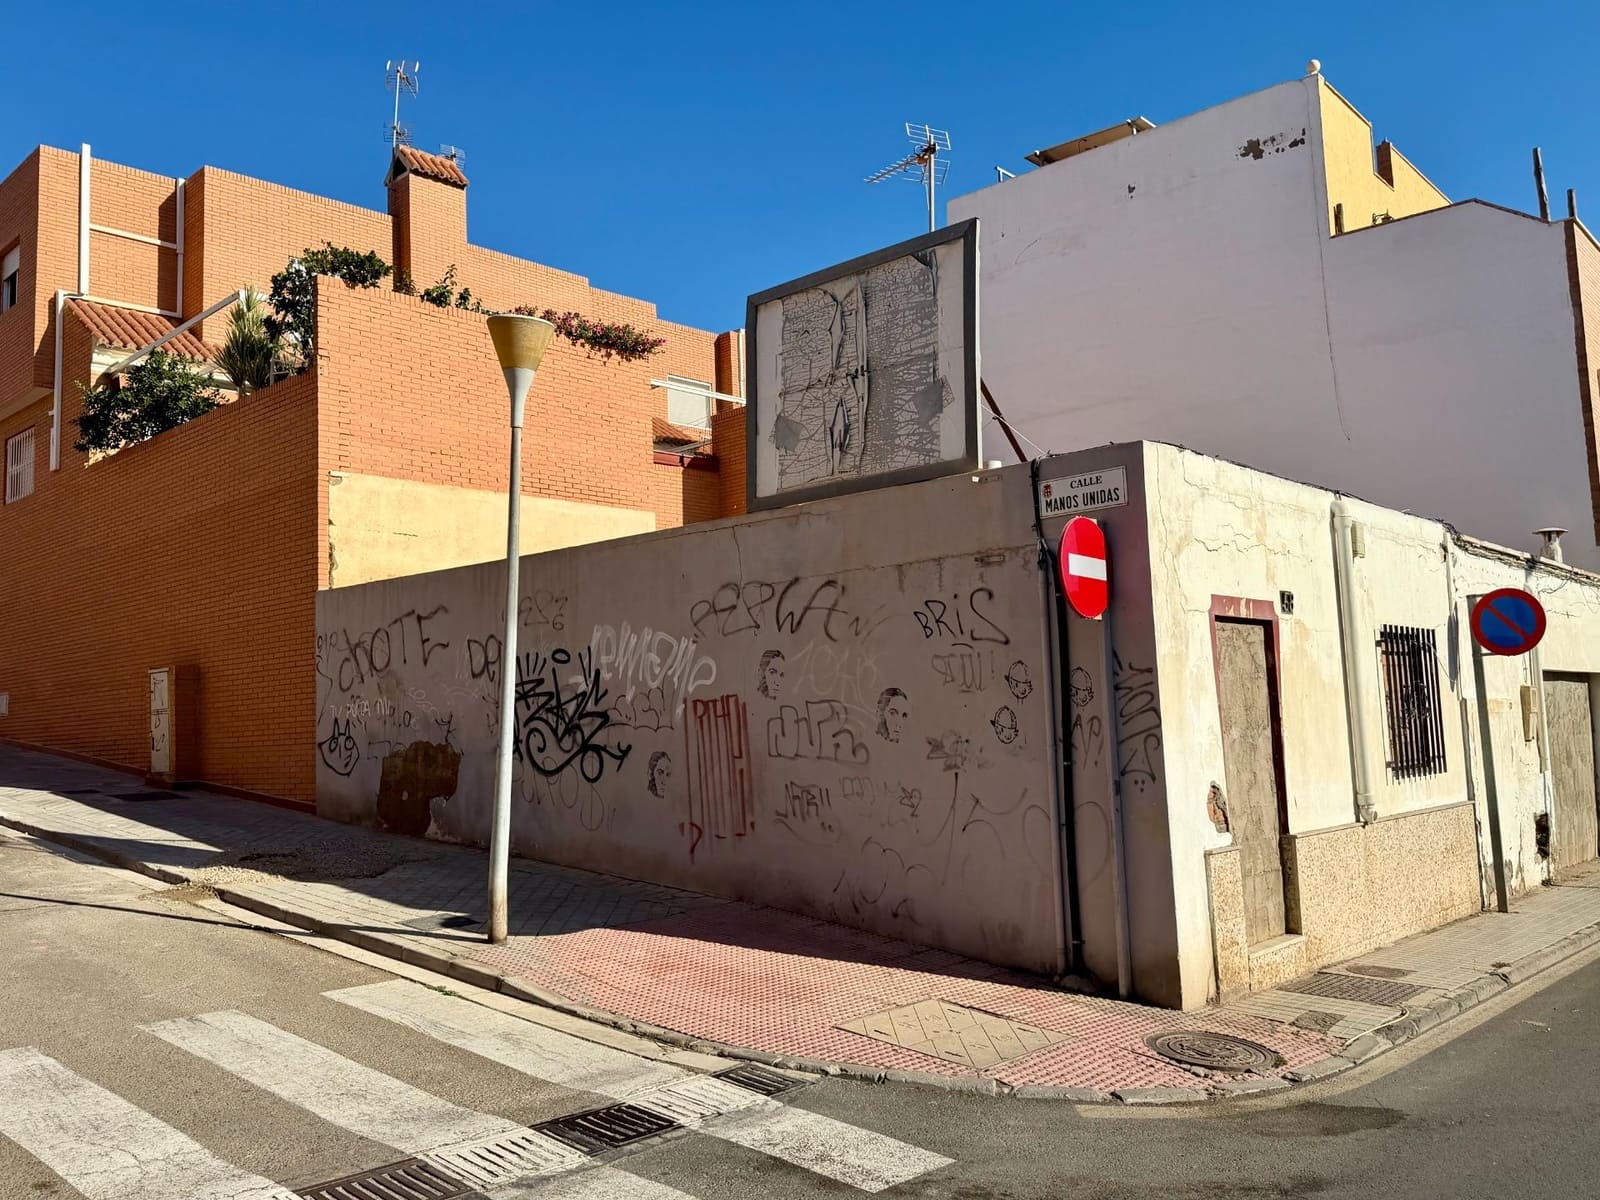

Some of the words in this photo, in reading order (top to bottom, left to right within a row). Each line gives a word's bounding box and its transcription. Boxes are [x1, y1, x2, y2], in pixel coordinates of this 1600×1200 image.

[1070, 475, 1102, 489] CALLE
[1045, 494, 1079, 513] MANOS
[1082, 487, 1120, 506] UNIDAS
